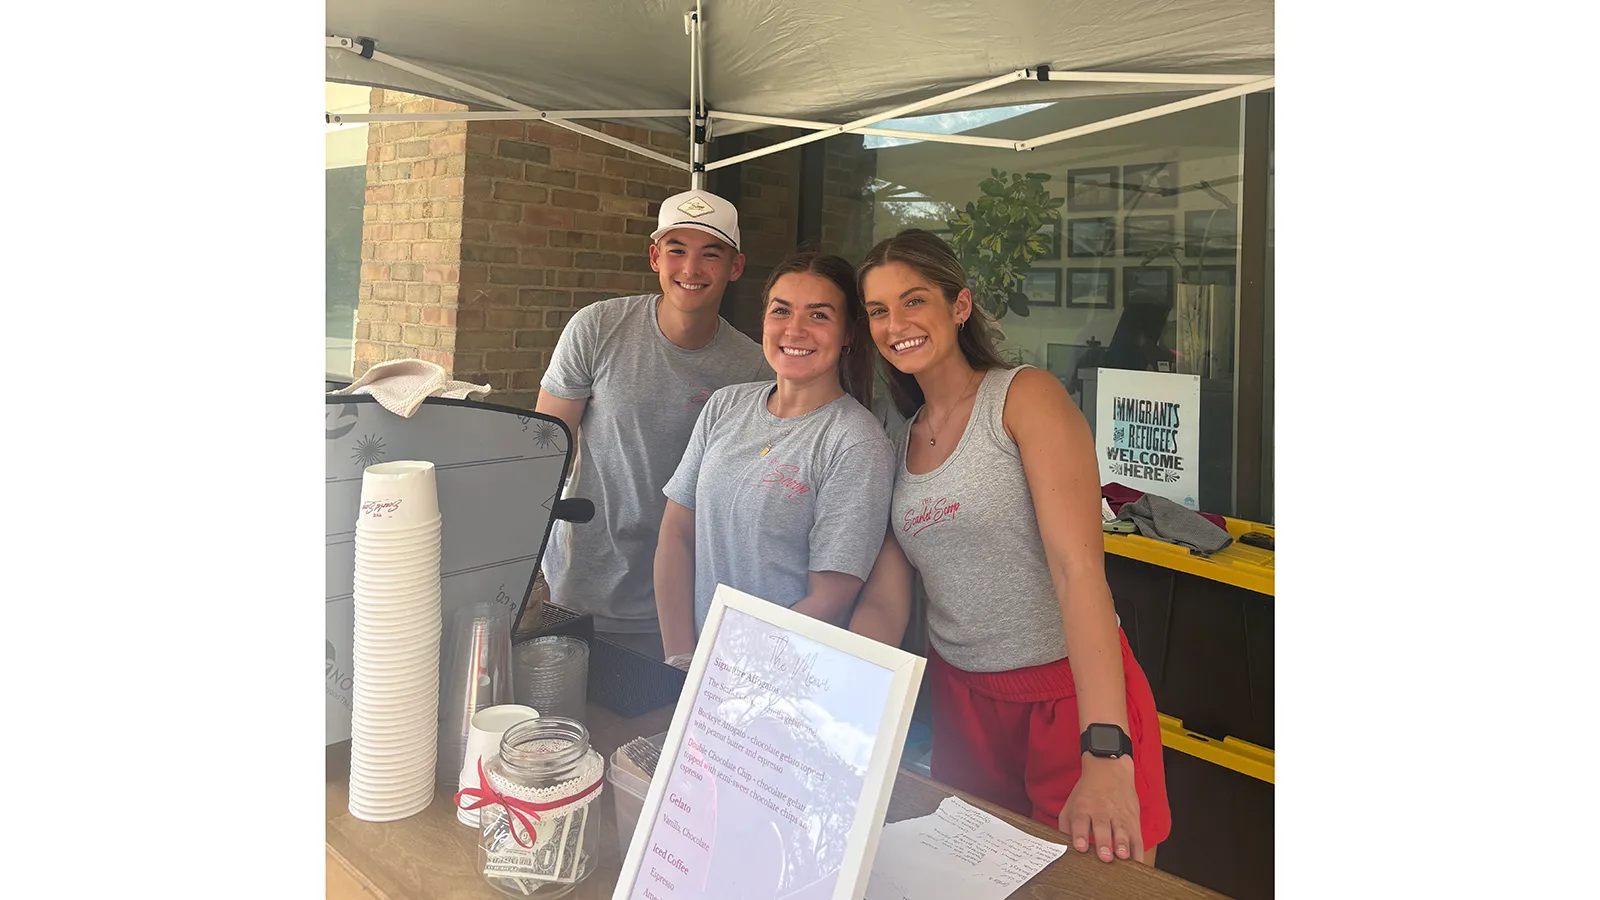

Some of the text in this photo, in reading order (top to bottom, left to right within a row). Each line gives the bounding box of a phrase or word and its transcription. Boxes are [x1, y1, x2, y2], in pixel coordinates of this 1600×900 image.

[1112, 396, 1180, 428] IMMIGRANTS
[1128, 423, 1178, 454] REFUGEES
[1106, 446, 1184, 471] WELCOME
[1123, 464, 1164, 482] HERE
[903, 497, 960, 532] Scarlet Scoop
[714, 657, 780, 695] Signature Affogatos
[768, 635, 831, 692] The Menu
[708, 677, 719, 689] The
[694, 719, 784, 775] with peanut butter and espresso
[697, 707, 722, 725] Buckeye
[721, 718, 747, 739] Affogato
[750, 735, 780, 757] chocolate
[780, 751, 800, 768] gelato
[679, 763, 703, 782] espresso
[687, 737, 707, 755] Double
[707, 749, 737, 772] Chocolate
[736, 765, 752, 782] Chip
[756, 777, 787, 801] chocolate
[669, 793, 692, 814] Gelato
[683, 751, 704, 769] topped
[703, 762, 717, 775] with
[716, 770, 750, 795] semi-sweet
[750, 789, 781, 813] chocolate
[780, 807, 799, 825] chips
[682, 827, 710, 852] Chocolate
[652, 842, 689, 876] Iced Coffee
[649, 866, 675, 891] Espresso
